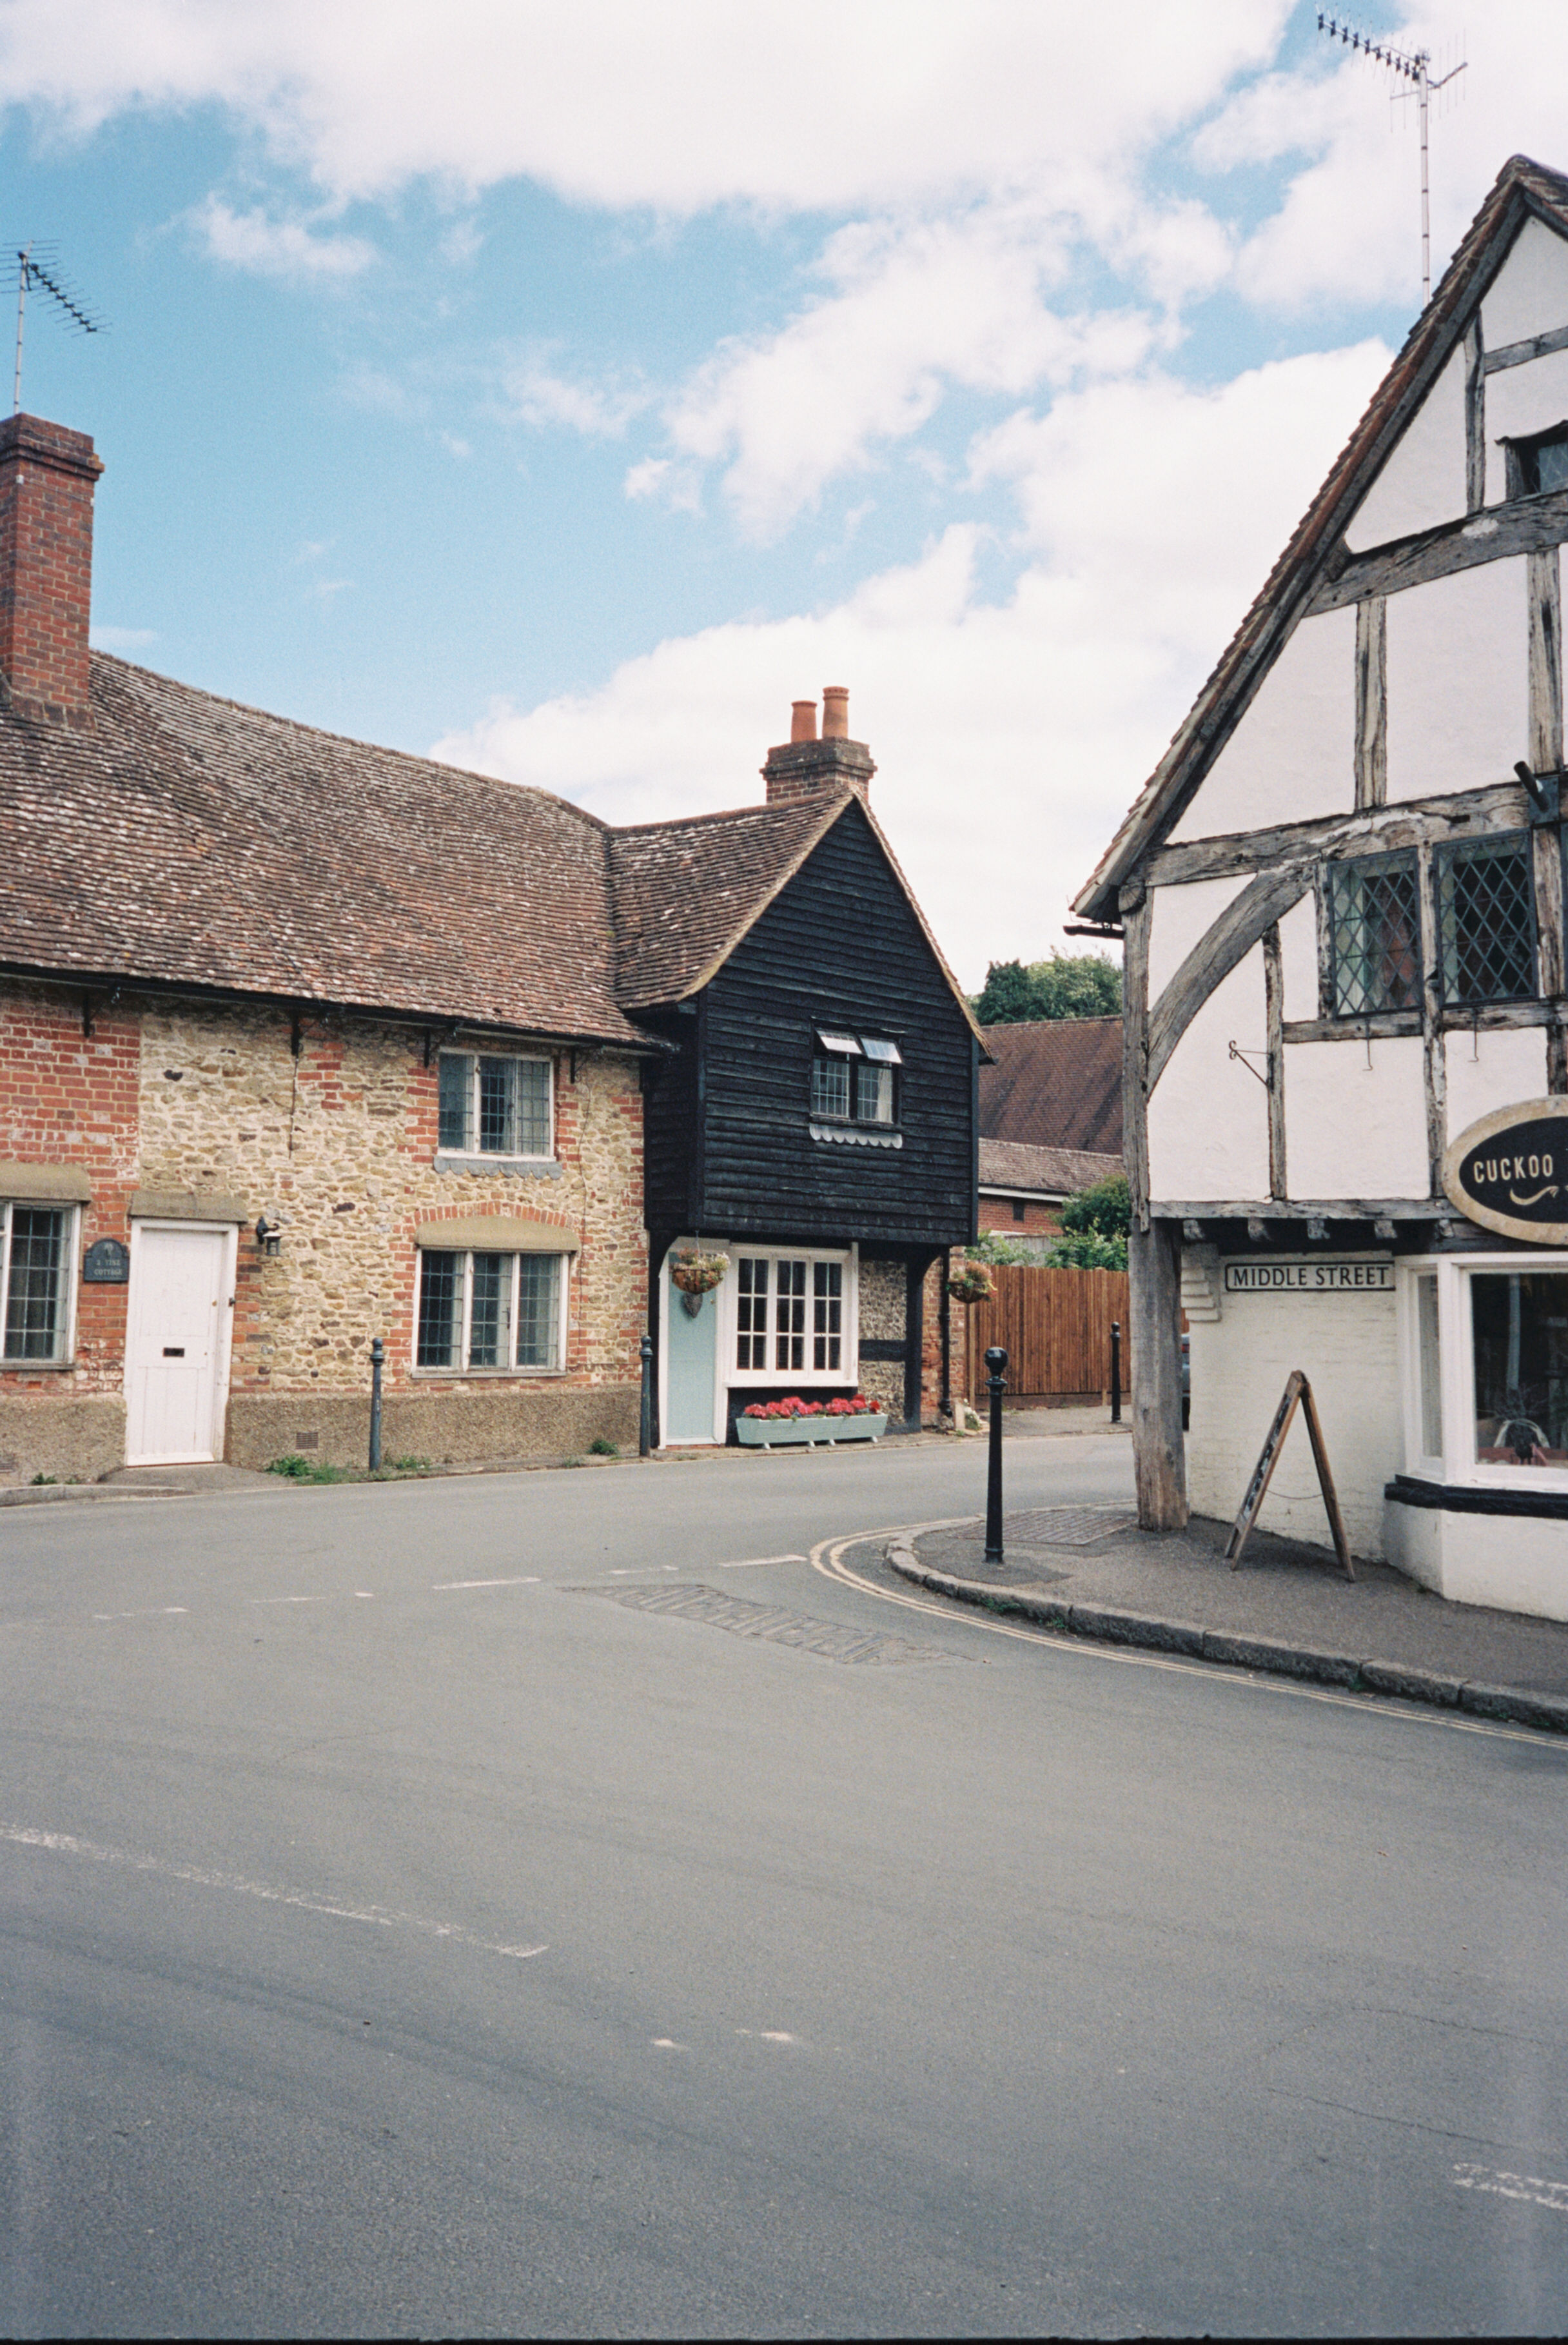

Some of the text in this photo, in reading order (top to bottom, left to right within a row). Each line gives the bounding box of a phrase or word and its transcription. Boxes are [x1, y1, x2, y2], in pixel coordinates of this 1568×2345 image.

[1473, 1154, 1553, 1183] CUCKOO
[1233, 1267, 1389, 1287] MIDDLE STREET
